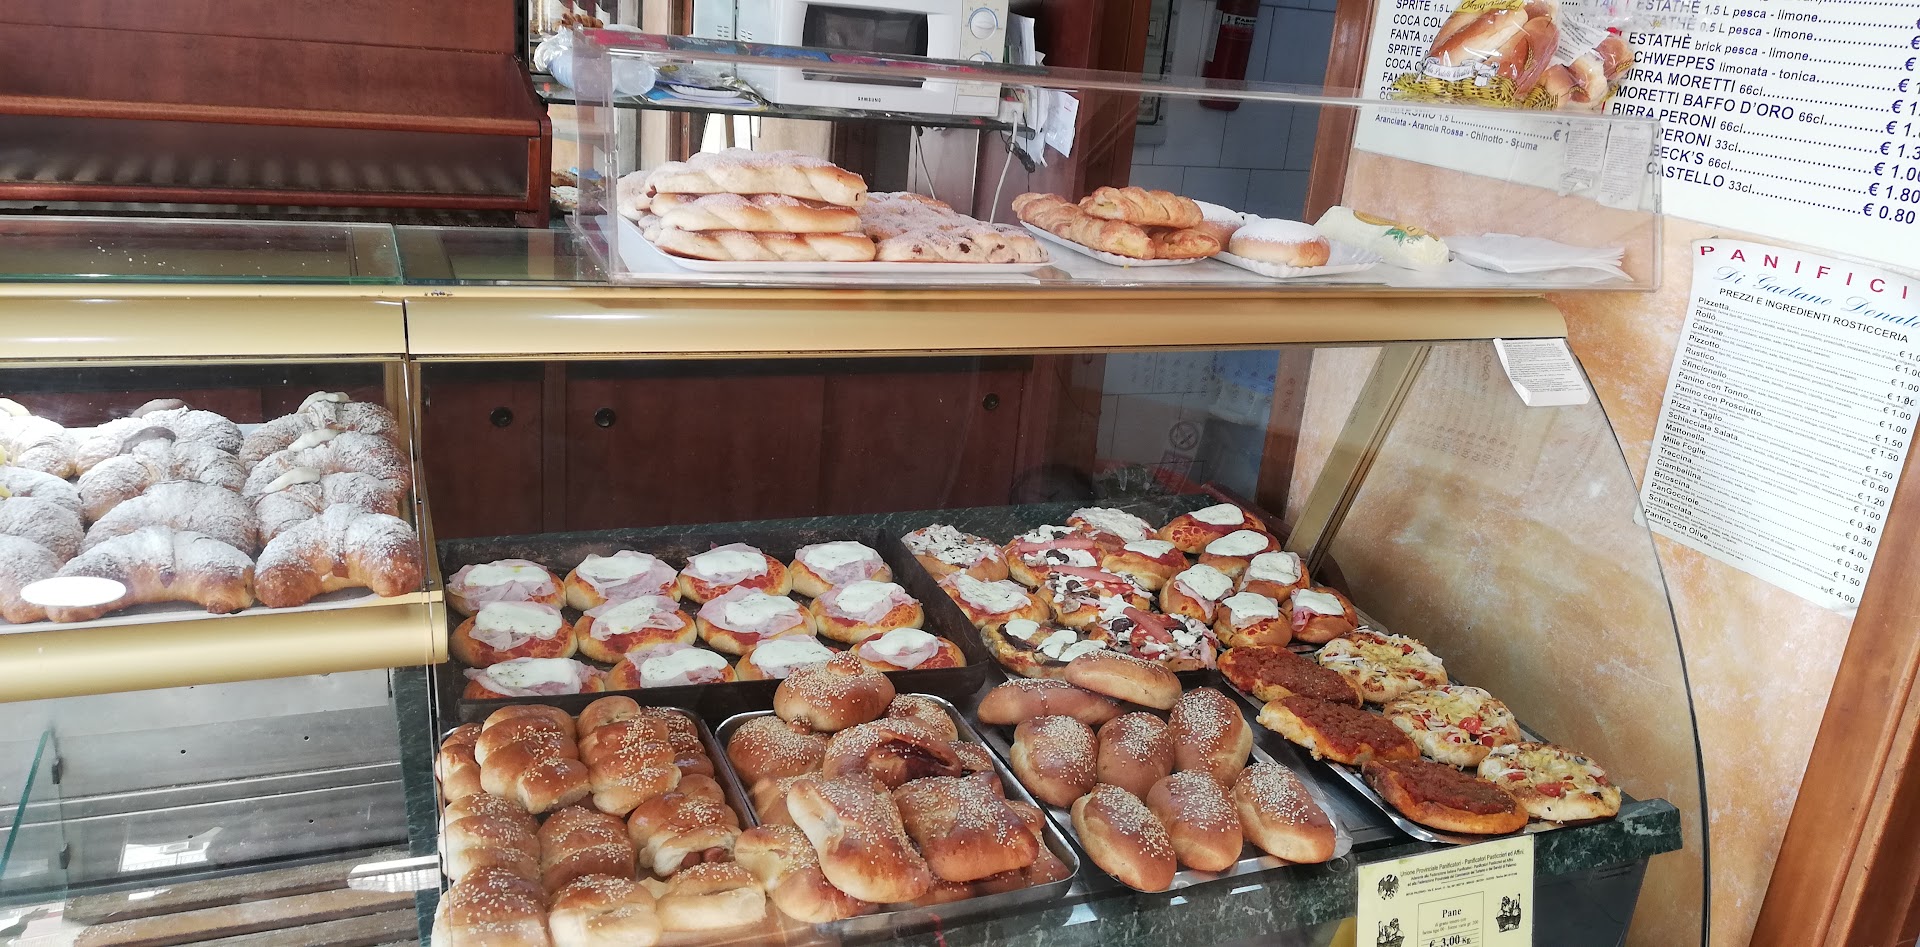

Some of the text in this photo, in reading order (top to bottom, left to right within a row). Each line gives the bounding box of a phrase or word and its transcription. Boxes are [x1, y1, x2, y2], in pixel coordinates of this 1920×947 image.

[1393, 14, 1442, 28] COCA COL
[1396, 0, 1431, 11] SPRITE
[1433, 4, 1444, 12] 1.5
[1704, 5, 1720, 15] 1.5
[1723, 6, 1729, 16] L
[1732, 9, 1767, 19] pesca
[1777, 9, 1818, 23] limone
[1387, 43, 1422, 57] SPRITE
[1390, 28, 1420, 42] FANTA
[1628, 32, 1692, 50] ESTATHÈ
[1694, 40, 1721, 53] brick
[1724, 45, 1758, 56] pesca
[1768, 47, 1809, 61] limone
[1719, 23, 1725, 33] L
[1728, 25, 1762, 36] pesca
[1772, 27, 1813, 40] limone
[1385, 57, 1412, 71] COCA
[1634, 50, 1715, 71] CHWEPPES
[1719, 62, 1768, 77] limonata
[1778, 69, 1817, 83] tonica
[1667, 72, 1736, 93] MORETTI
[1739, 84, 1764, 97] 66cl
[1616, 85, 1679, 105] MORETTI
[1683, 93, 1736, 112] BAFFO
[1739, 101, 1794, 120] D'ORO
[1798, 111, 1824, 125] 66cl
[1375, 113, 1538, 151] Aranciata Arancia Rossa Chinotto Spuma
[1612, 102, 1654, 117] BIRRA
[1659, 109, 1716, 129] PERONI
[1719, 120, 1743, 133] 66cl
[1897, 143, 1920, 160] 1.3
[1714, 139, 1739, 152] 33cl
[1646, 162, 1725, 188] CASTELLO
[1728, 180, 1752, 194] 33cl
[1879, 205, 1916, 225] 0.80
[1708, 157, 1731, 171] 66cl
[1885, 185, 1920, 204] 1.80
[1700, 245, 1908, 300] PANIFICI
[1713, 265, 1746, 285] Di
[1752, 273, 1833, 305] Gaetano
[1695, 309, 1716, 321] Rollò
[1698, 296, 1729, 311] Pizzetta
[1719, 287, 1755, 303] PREZZI
[1756, 296, 1764, 305] E
[1765, 299, 1831, 323] INGREDIENTI
[1832, 316, 1909, 343] ROSTICCERIA
[1688, 334, 1720, 349] Pizzotto
[1692, 322, 1724, 336] Calzone
[1900, 381, 1919, 393] 1.00
[1681, 359, 1727, 379] Sfincionello
[1888, 423, 1907, 435] 1.00
[1685, 346, 1715, 361] Rustico
[1892, 409, 1911, 421] 1.00
[1675, 383, 1701, 397] Panino
[1703, 393, 1718, 403] con
[1720, 397, 1762, 417] Prosciutto
[1880, 450, 1899, 462] 1.50
[1678, 371, 1705, 385] Panino
[1706, 382, 1721, 391] con
[1724, 385, 1748, 399] Tonno
[1884, 437, 1903, 449] 1.50
[1660, 446, 1692, 464] Treccina
[1668, 411, 1712, 432] Schiacciata
[1713, 426, 1738, 441] Salata
[1869, 481, 1889, 494] 0.60
[1670, 398, 1691, 411] Pizza
[1700, 408, 1722, 422] Taglio
[1874, 468, 1893, 480] 1.50
[1654, 470, 1690, 489] Brioscina
[1662, 435, 1680, 446] Mille
[1682, 441, 1706, 456] Foglie
[1862, 508, 1881, 521] 1.00
[1665, 423, 1705, 442] Mattonella
[1866, 495, 1885, 507] 1.20
[1656, 458, 1702, 481] Ciambellina
[1853, 534, 1872, 548] 0.30
[1644, 508, 1671, 524] Panino
[1672, 521, 1687, 531] con
[1688, 527, 1709, 540] Olive
[1836, 591, 1855, 604] 4.00
[1648, 493, 1692, 516] Schiacciata
[1842, 574, 1860, 587] 1.50
[1844, 561, 1864, 574] 0.30
[1442, 908, 1462, 918] Pane
